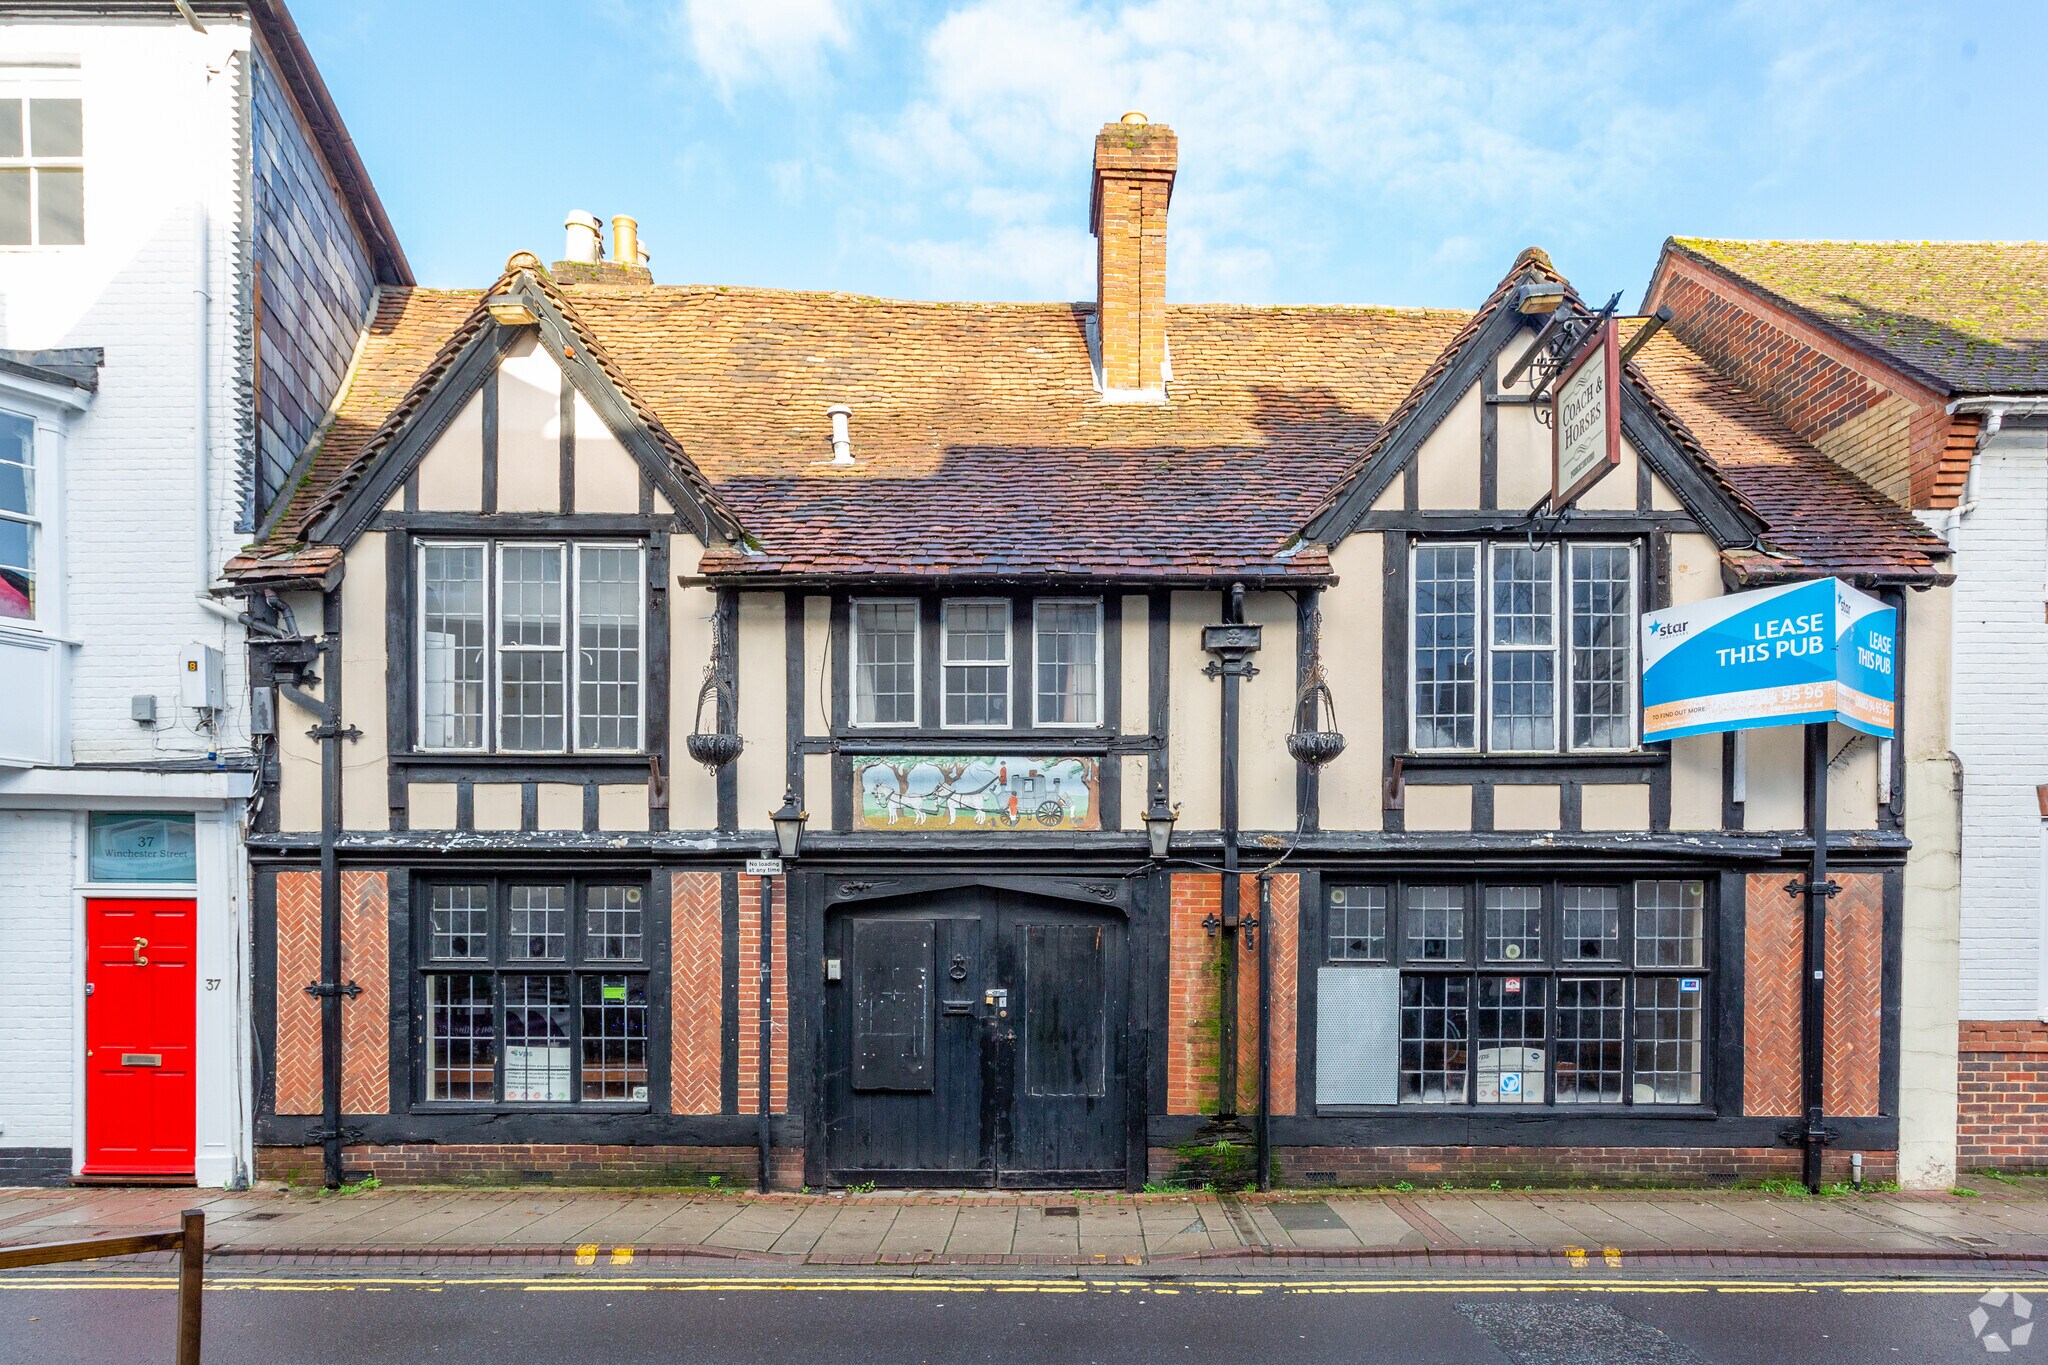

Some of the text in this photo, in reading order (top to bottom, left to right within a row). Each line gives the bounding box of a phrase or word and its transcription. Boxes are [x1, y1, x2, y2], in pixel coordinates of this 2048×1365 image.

[1562, 376, 1603, 427] COACH &
[1564, 402, 1601, 450] HORSES
[1660, 621, 1688, 636] star
[1754, 613, 1824, 640] LEASE
[1716, 636, 1824, 667] THIS PUB
[1870, 630, 1892, 654] LEASE
[1858, 646, 1891, 675] THIS PUB
[1804, 684, 1824, 700] 96
[104, 849, 187, 858] Winchester Street
[137, 836, 154, 848] 37
[205, 978, 222, 991] 37
